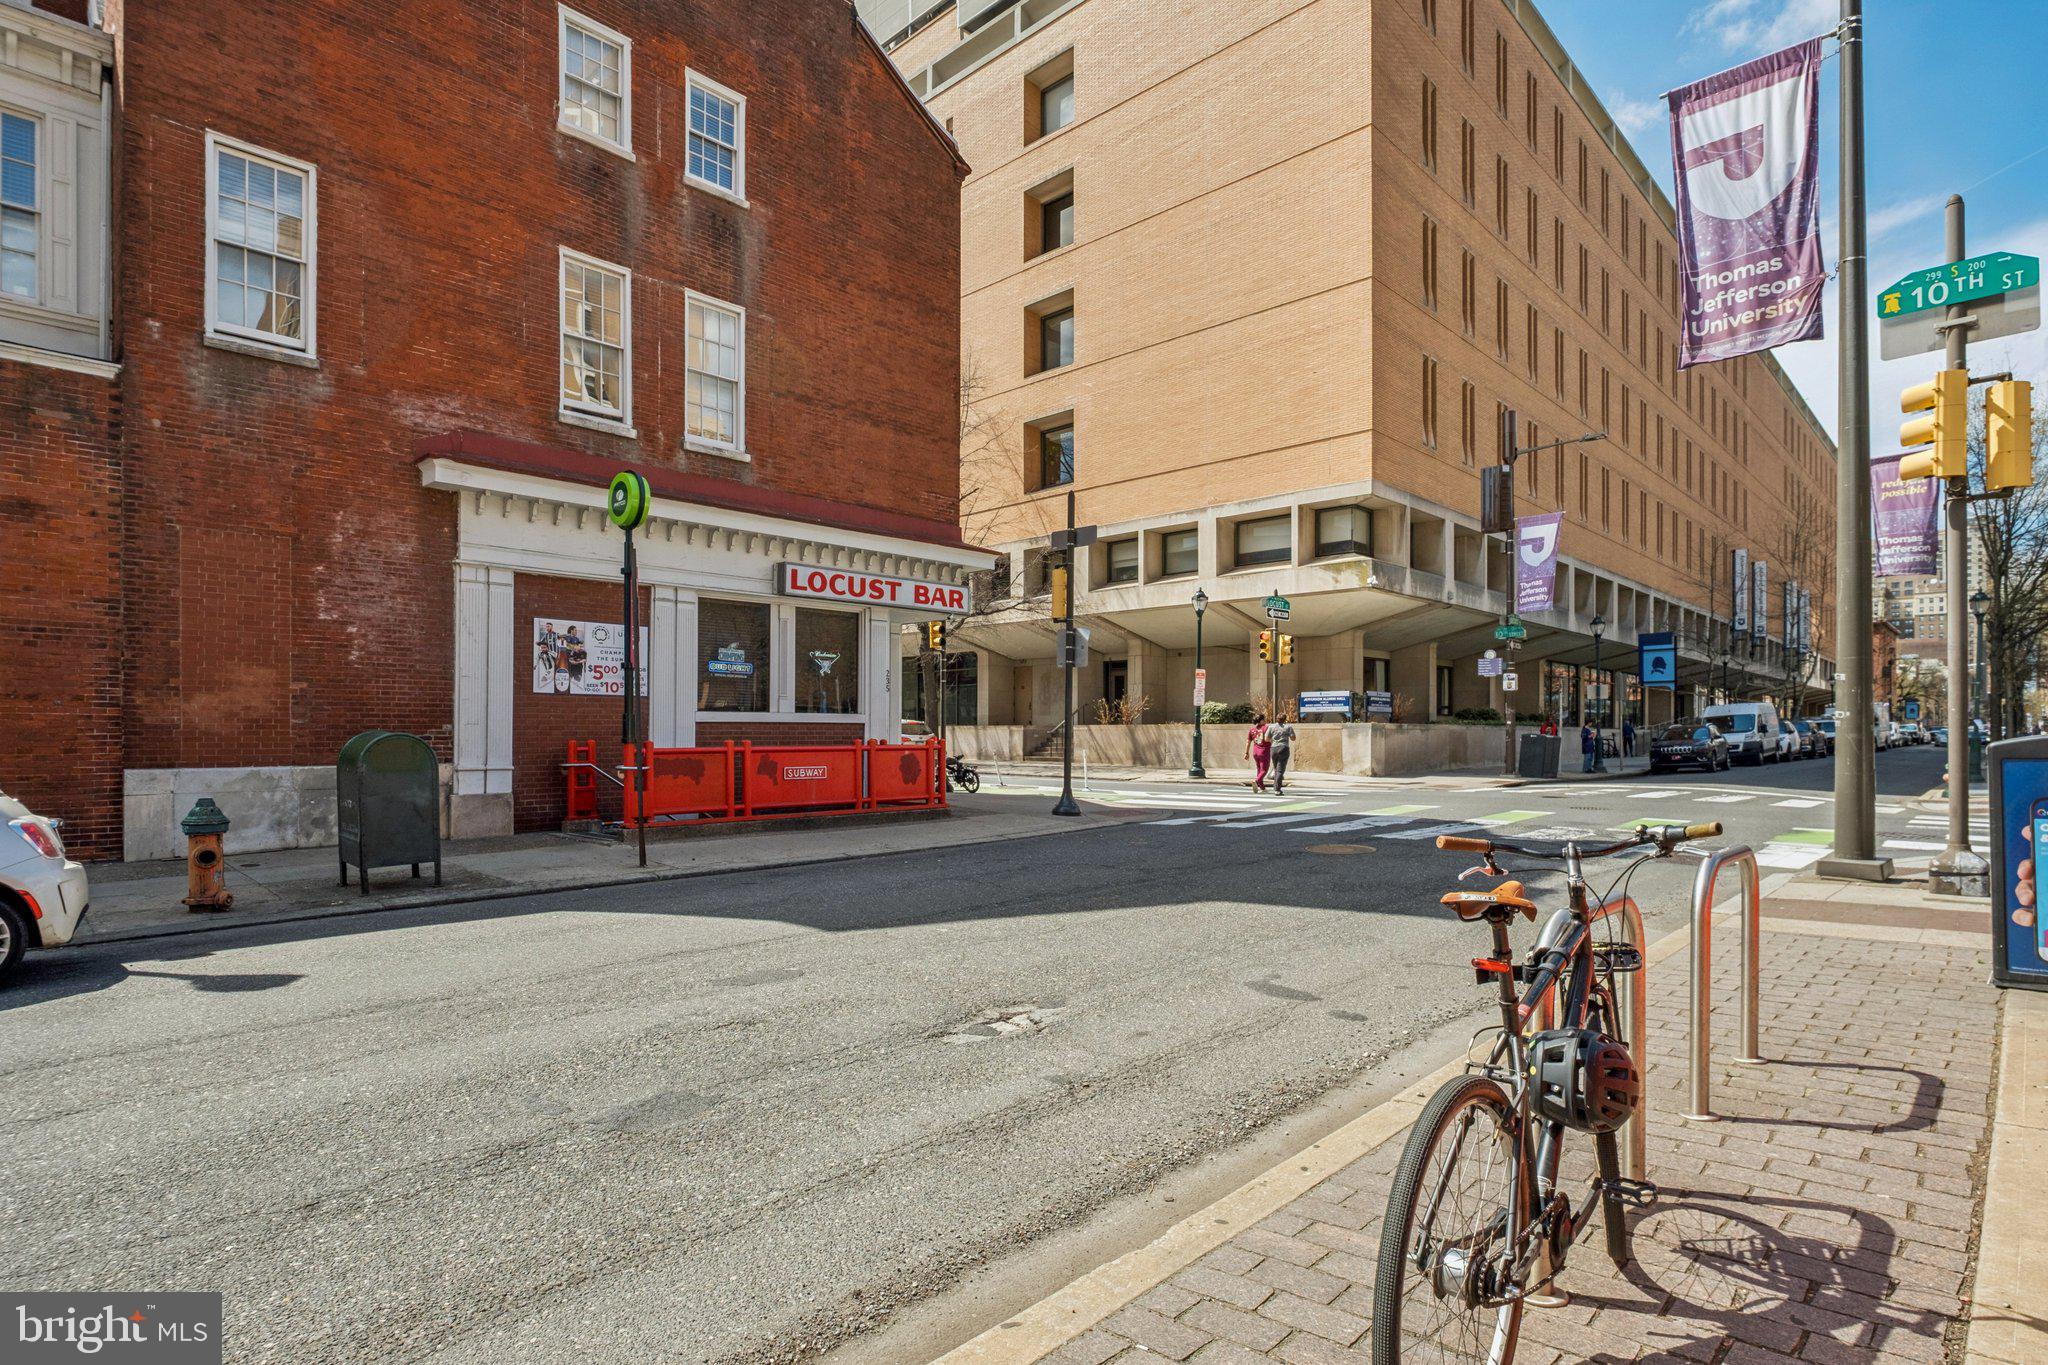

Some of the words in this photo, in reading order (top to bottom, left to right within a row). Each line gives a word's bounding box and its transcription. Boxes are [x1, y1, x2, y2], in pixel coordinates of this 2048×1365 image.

[1691, 257, 1783, 293] Thomas
[1925, 270, 1942, 282] 299
[1950, 265, 1959, 278] S
[1967, 260, 1986, 272] 200
[1690, 275, 1801, 316] Jefferson
[1911, 272, 1984, 309] 10TH
[2001, 270, 2024, 290] ST
[1691, 295, 1808, 337] University
[1881, 485, 1928, 500] possible
[1878, 535, 1924, 546] Thomas
[1879, 544, 1931, 556] Jefferson
[1880, 554, 1934, 565] University
[790, 568, 902, 601] LOCUST
[914, 584, 964, 609] BAR
[1519, 579, 1543, 590] Thomas
[1519, 586, 1548, 597] Jefferson
[1519, 594, 1549, 605] University
[711, 662, 727, 671] BUD
[728, 664, 751, 673] LIGHT
[787, 768, 824, 778] SUBWAY
